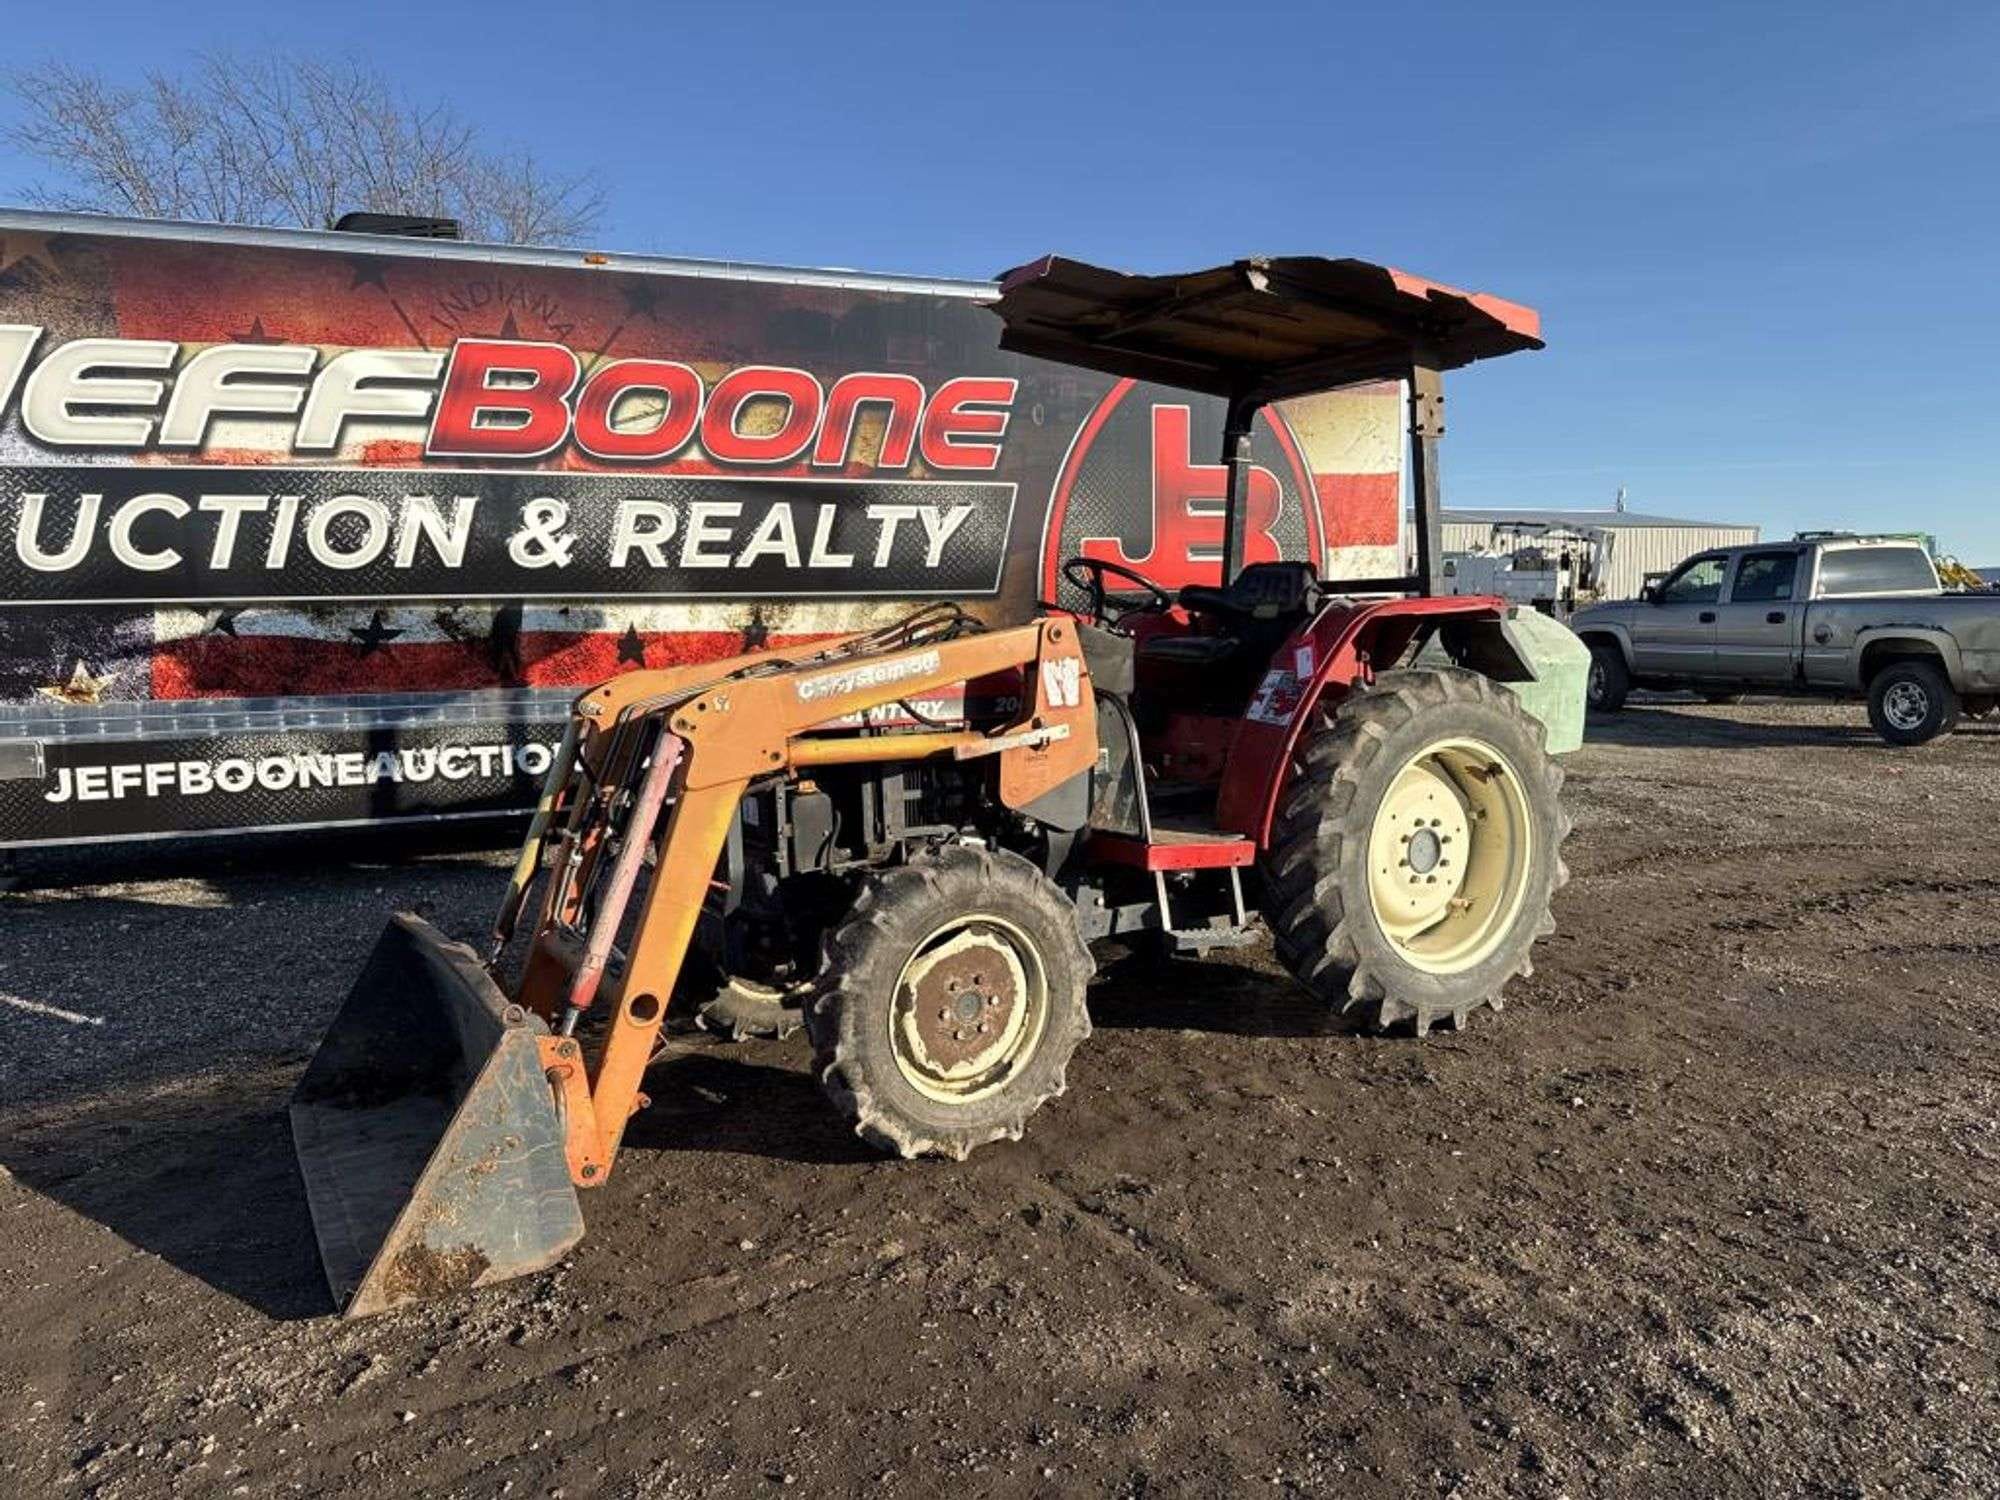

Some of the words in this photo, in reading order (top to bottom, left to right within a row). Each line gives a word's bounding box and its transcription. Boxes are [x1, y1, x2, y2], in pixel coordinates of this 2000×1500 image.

[507, 497, 577, 570] &
[608, 499, 973, 569] REALTY
[838, 700, 945, 722] NTURY
